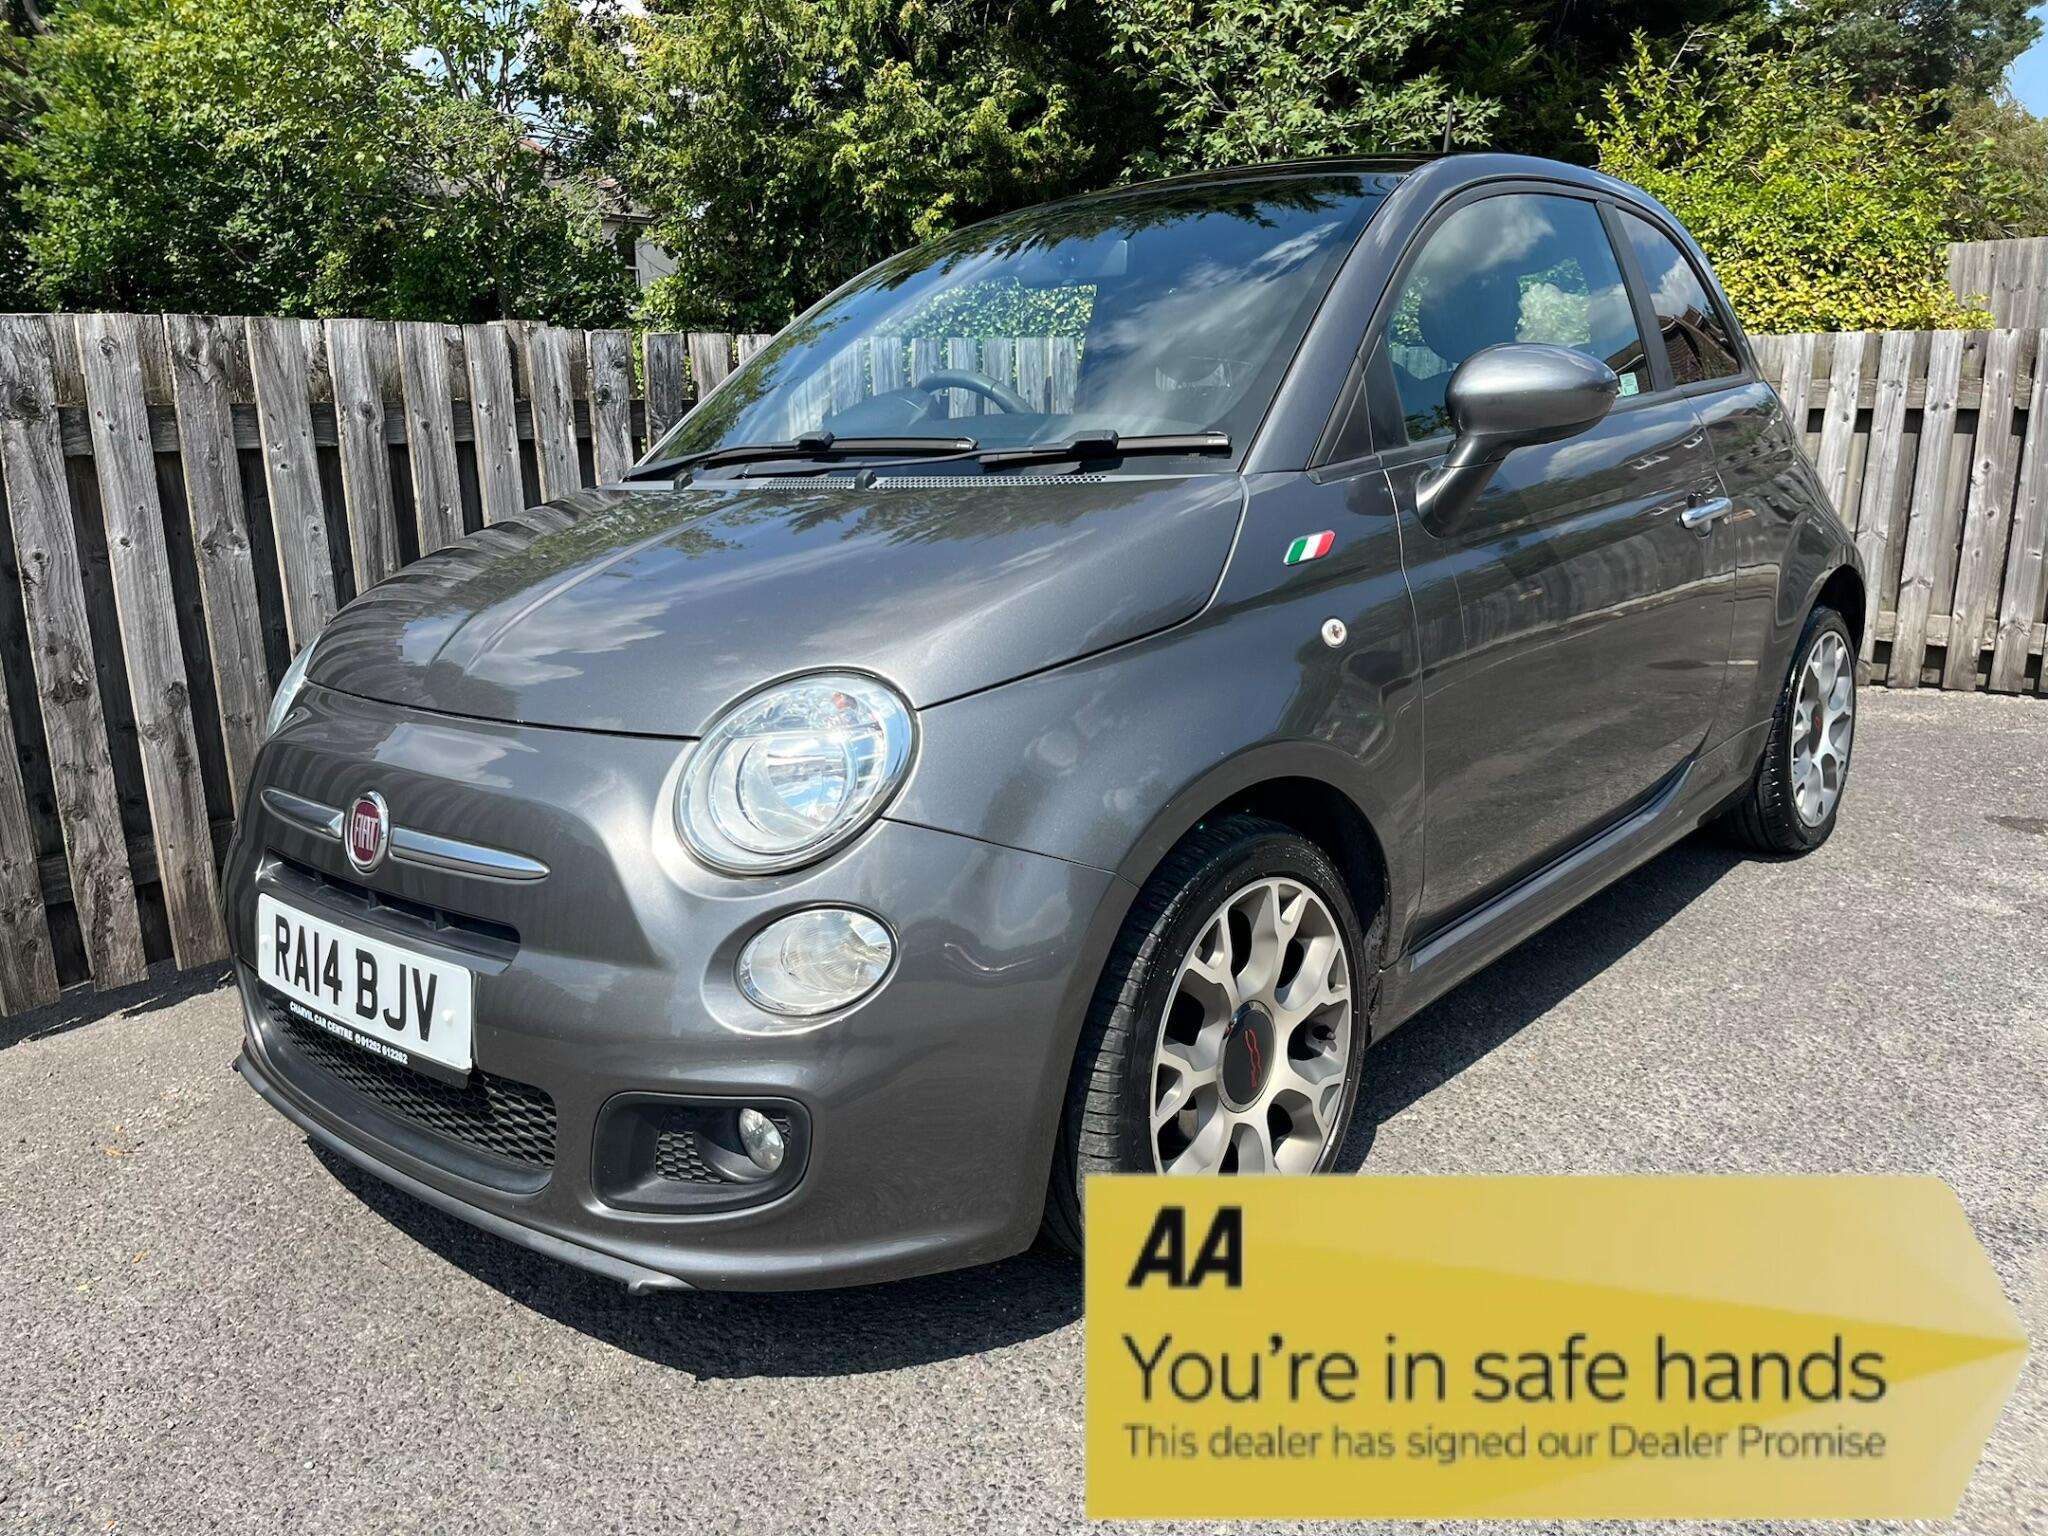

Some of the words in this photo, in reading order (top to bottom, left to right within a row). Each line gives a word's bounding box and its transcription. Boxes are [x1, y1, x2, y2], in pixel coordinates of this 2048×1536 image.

[354, 812, 379, 851] FIAT
[274, 913, 343, 1006] RA14
[355, 947, 438, 1042] BJV
[314, 1014, 327, 1029] CAR
[327, 1020, 353, 1041] CENTRE
